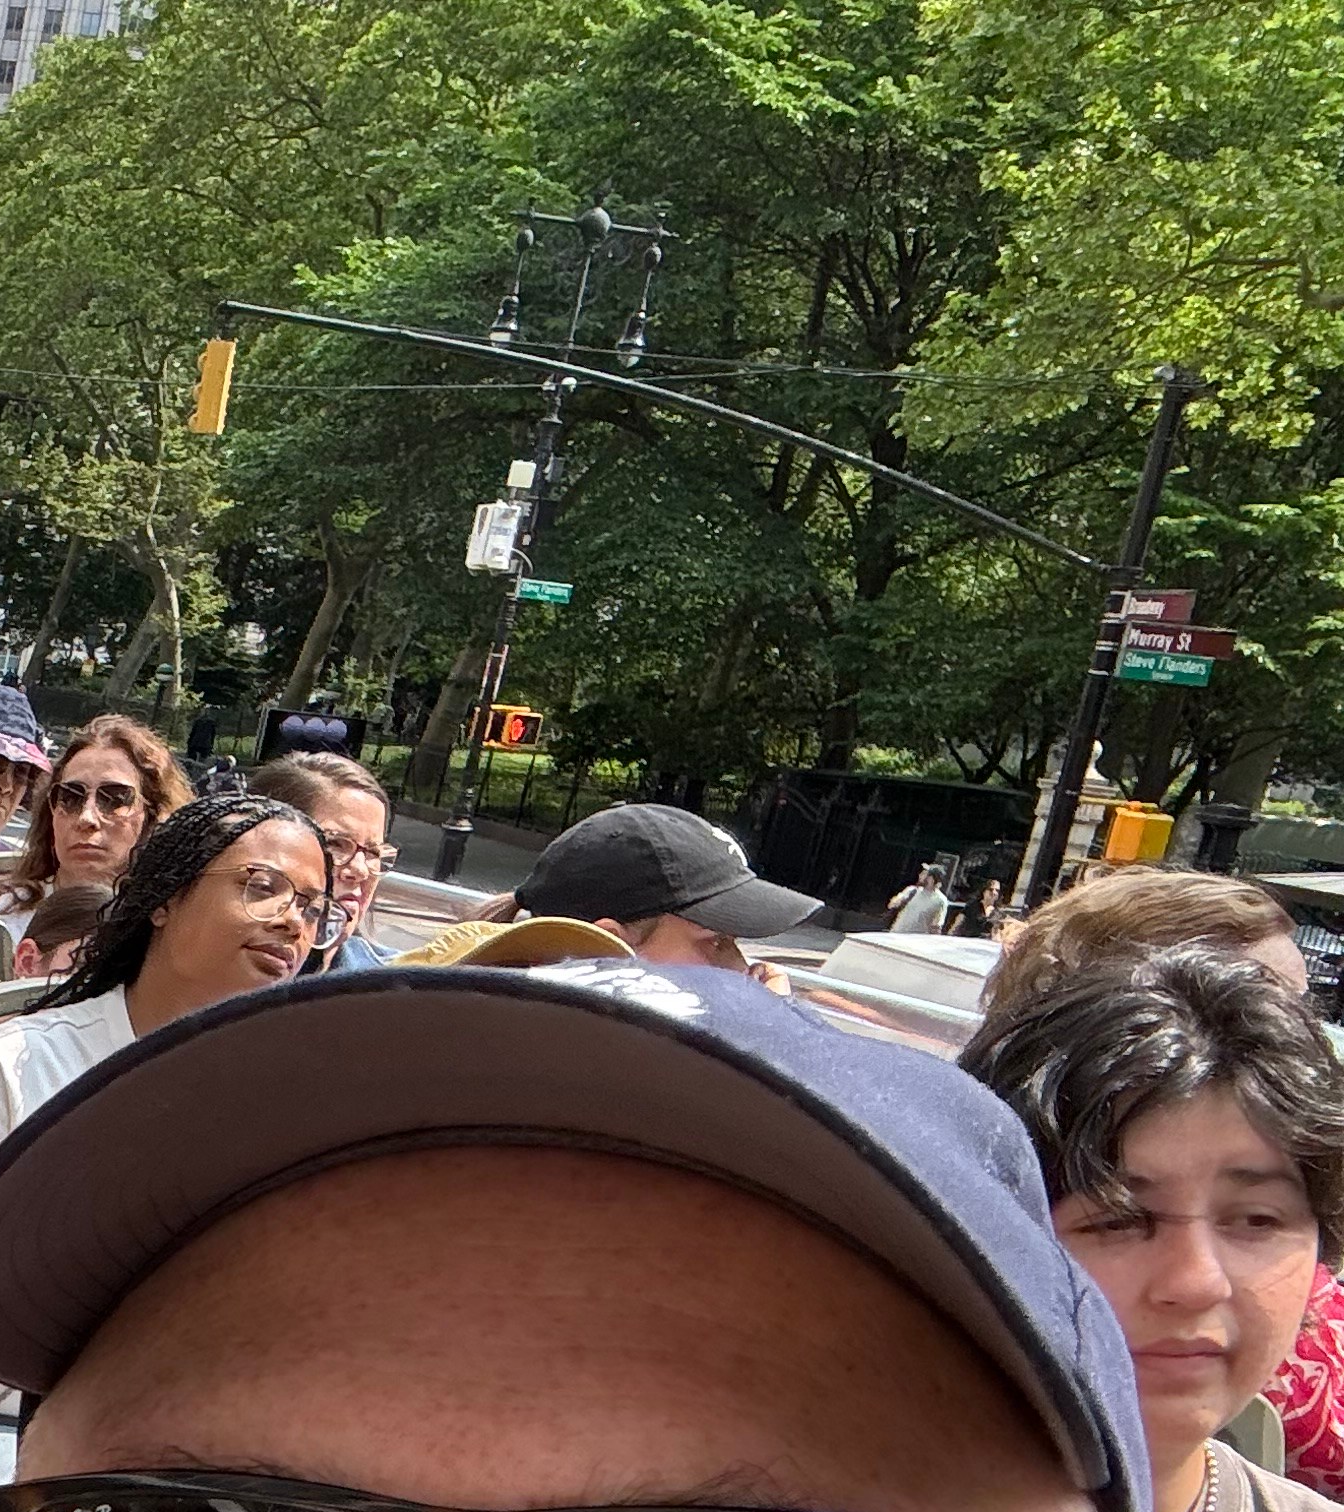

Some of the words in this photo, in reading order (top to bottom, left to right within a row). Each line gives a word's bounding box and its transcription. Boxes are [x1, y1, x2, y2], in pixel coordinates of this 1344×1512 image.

[1127, 628, 1174, 653] Murray
[1176, 631, 1192, 652] St
[1123, 652, 1156, 669] Steve
[1158, 656, 1207, 676] Flanders
